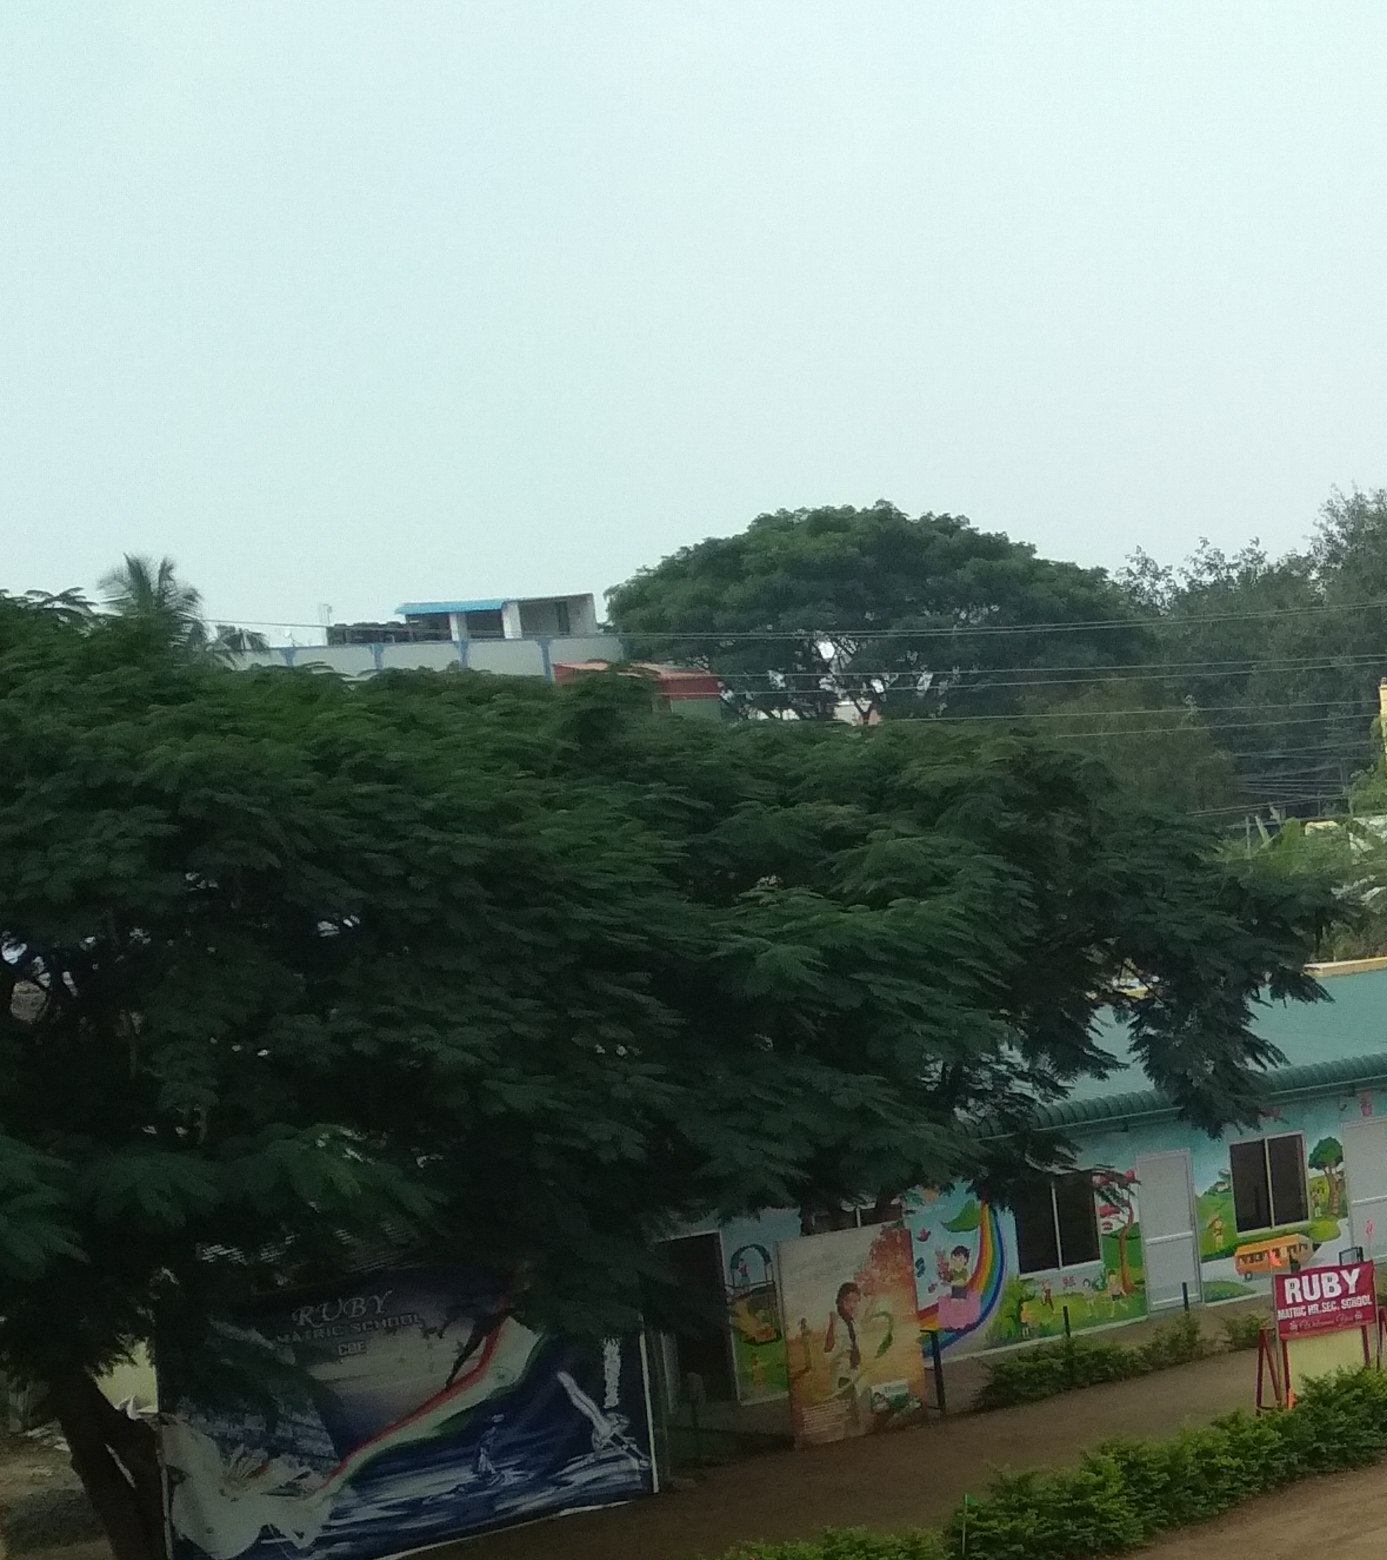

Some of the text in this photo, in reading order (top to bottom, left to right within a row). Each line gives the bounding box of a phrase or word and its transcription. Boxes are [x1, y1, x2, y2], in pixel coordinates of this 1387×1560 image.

[1284, 1268, 1360, 1305] RUBY
[291, 1289, 394, 1329] RUBY
[1341, 1295, 1373, 1310] SCHOOL
[350, 1315, 420, 1333] SCHOOL
